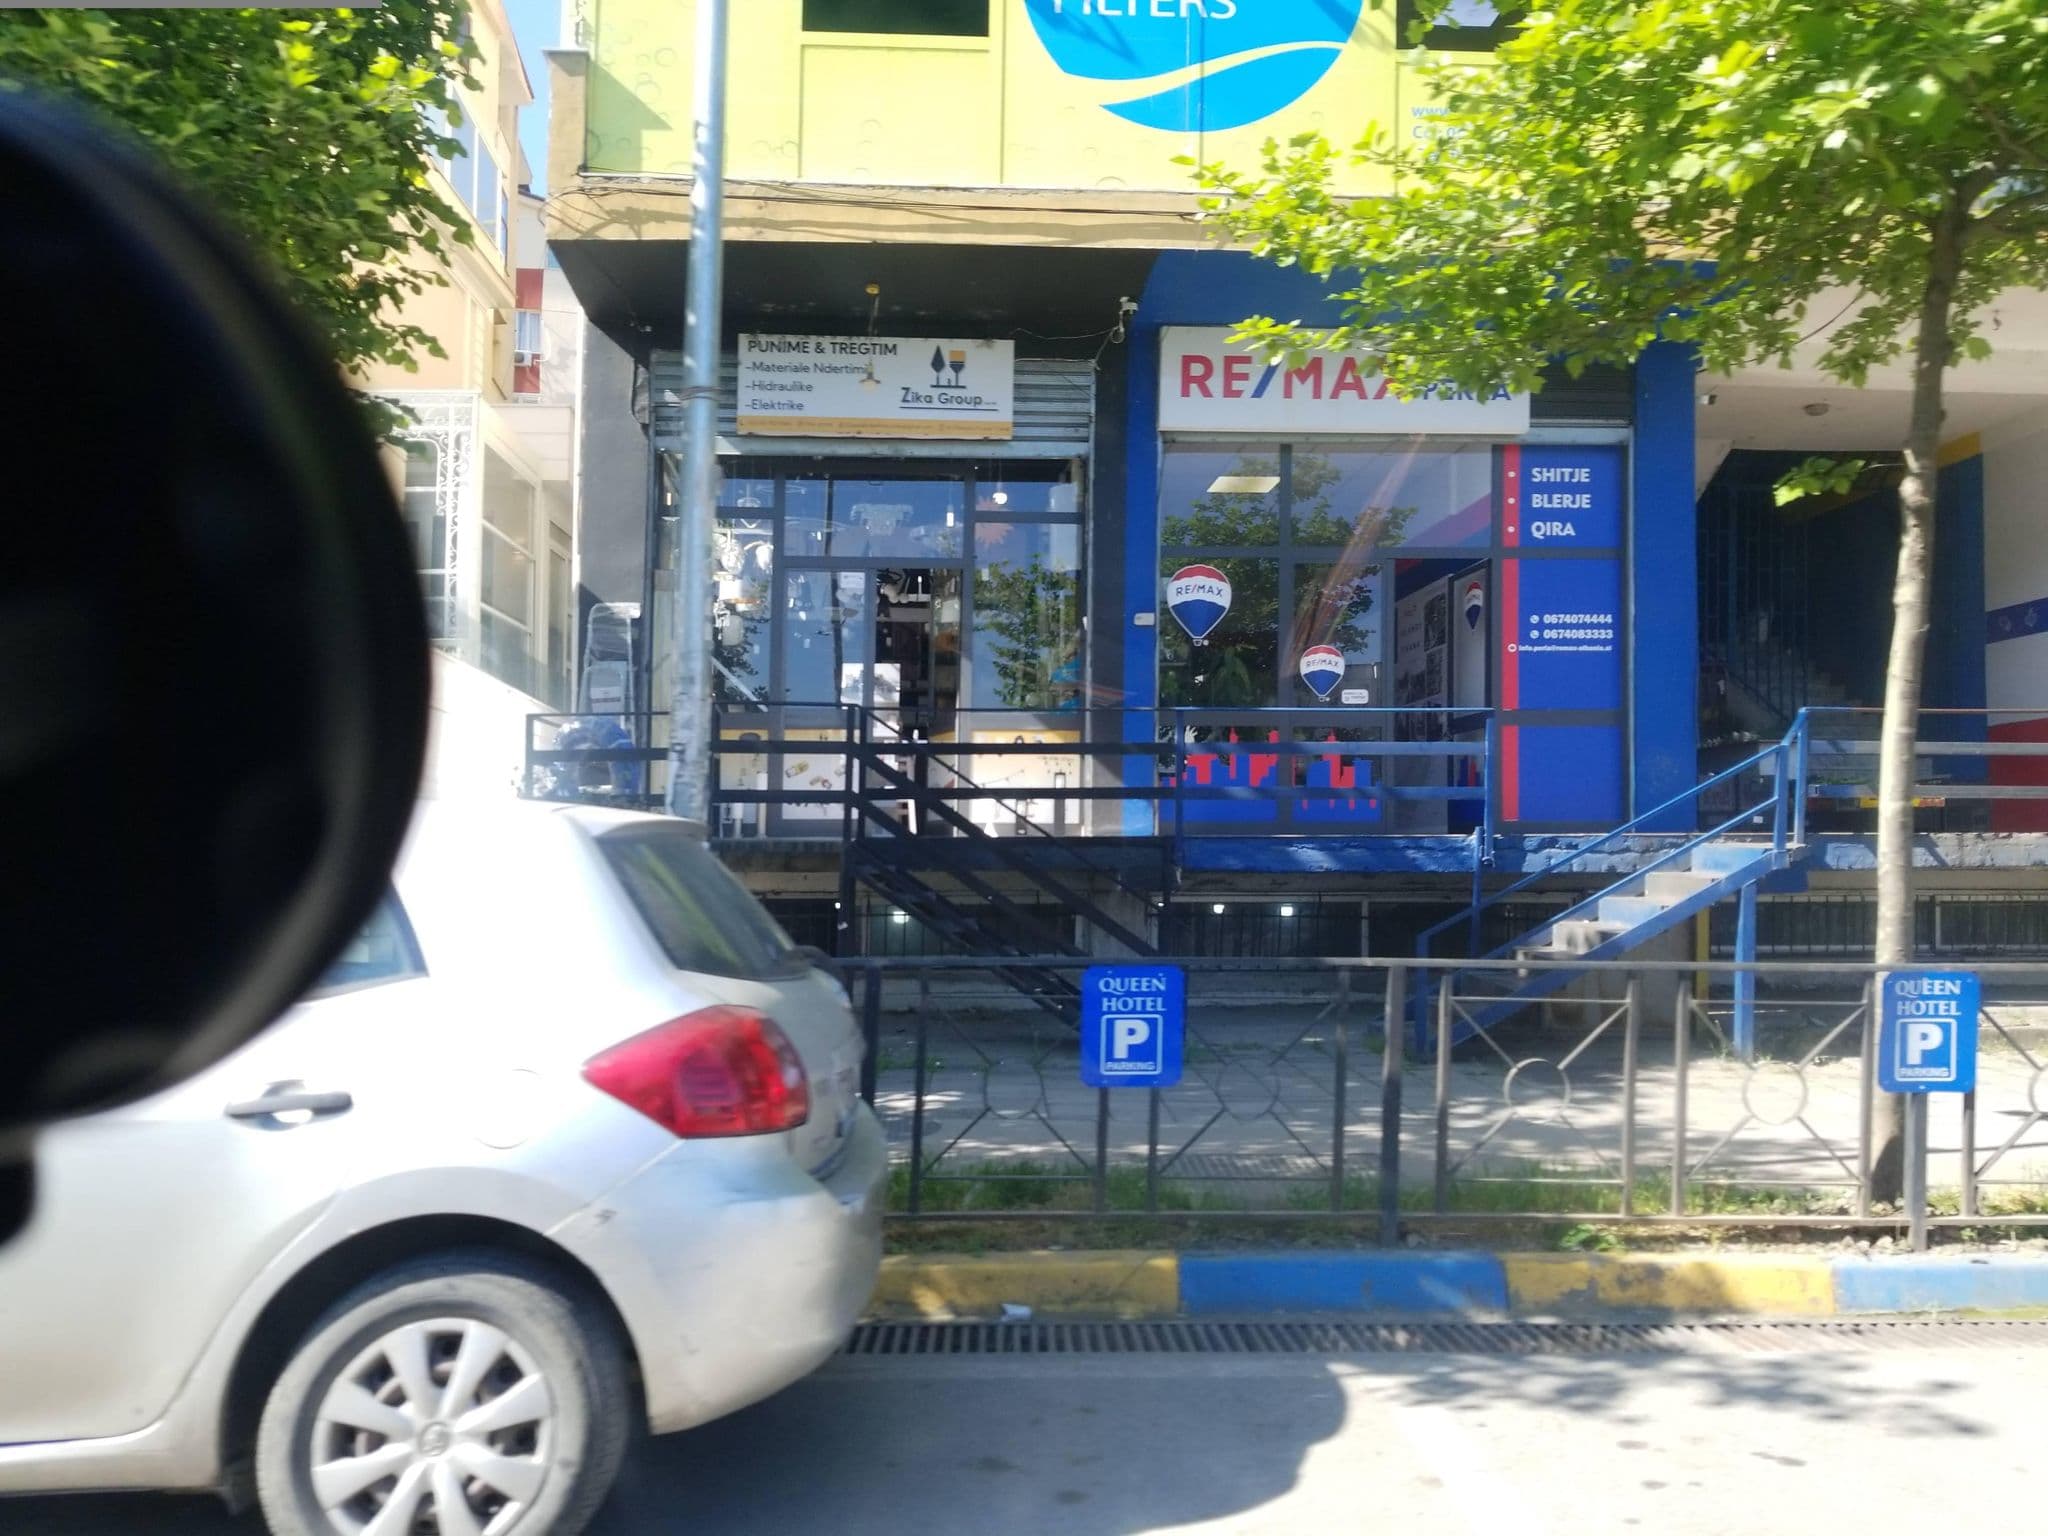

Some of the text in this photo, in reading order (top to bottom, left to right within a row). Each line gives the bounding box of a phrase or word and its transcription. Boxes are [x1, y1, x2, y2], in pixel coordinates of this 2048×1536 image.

[748, 340, 897, 355] PUNIME & TREGTIM
[901, 387, 983, 407] Zika Group
[1531, 467, 1591, 483] SHITJE
[1531, 493, 1592, 509] BLERJE
[1531, 521, 1576, 539] QIRA
[1175, 583, 1224, 598] RE/MAX
[1099, 977, 1167, 995] QUEEN
[1895, 979, 1962, 998] QUEEN
[1102, 997, 1167, 1012] HOTEL
[1896, 1000, 1962, 1016] HOTEL
[1113, 1019, 1150, 1059] P
[1906, 1023, 1944, 1065] P
